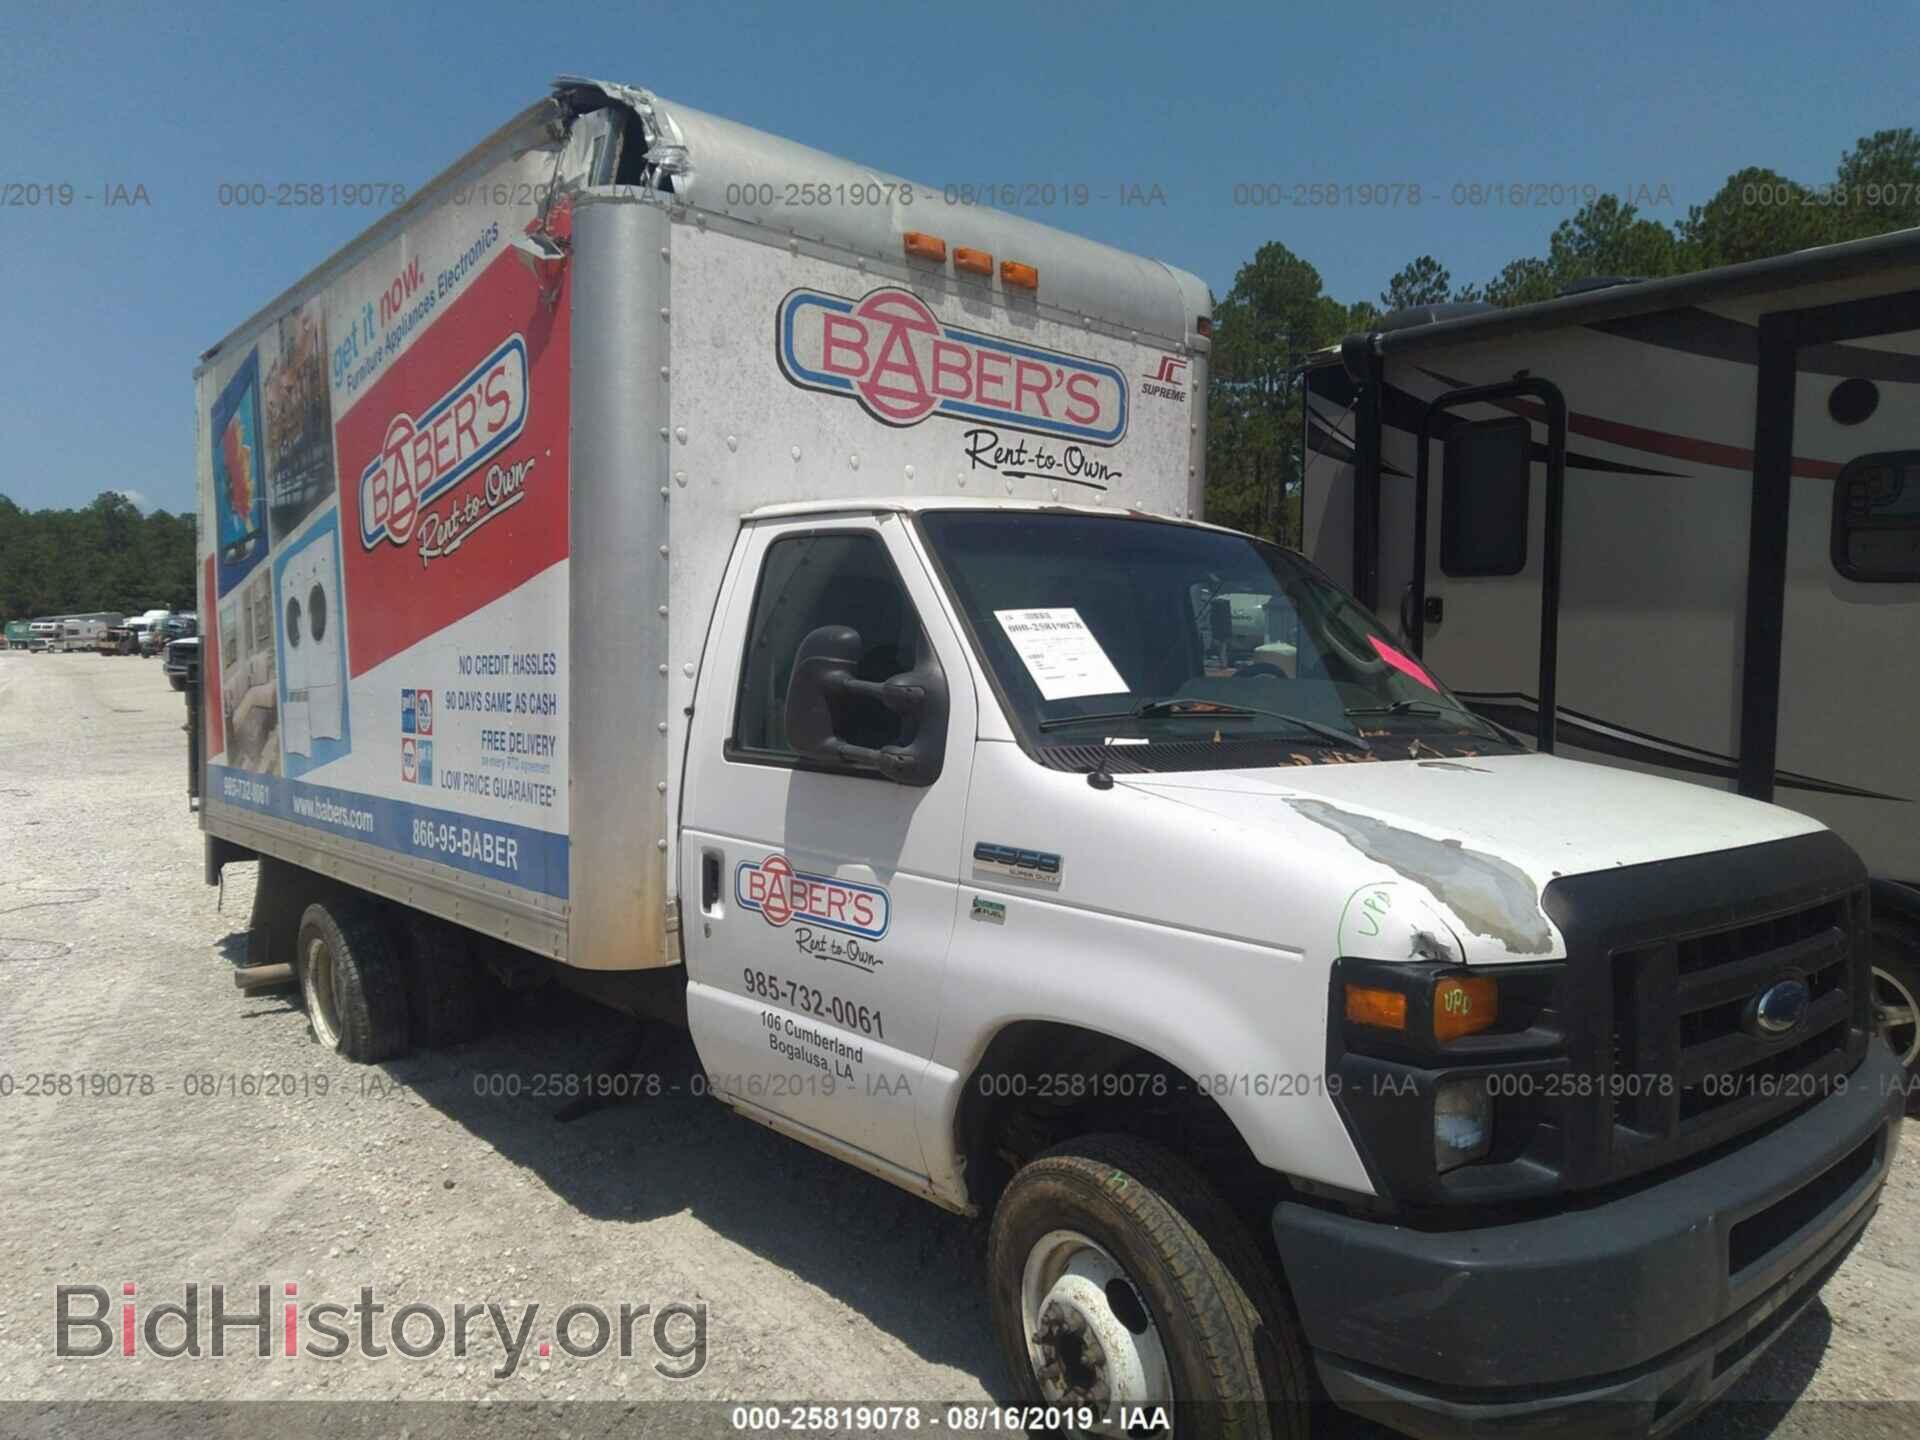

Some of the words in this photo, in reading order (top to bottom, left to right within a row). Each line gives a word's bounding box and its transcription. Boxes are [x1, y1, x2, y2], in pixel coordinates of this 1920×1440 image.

[384, 290, 436, 354] Appliances
[437, 221, 499, 299] Electronics
[333, 320, 358, 388] get
[362, 301, 376, 346] it
[380, 254, 424, 328] now.
[822, 308, 1101, 426] BABER'S
[1142, 382, 1187, 403] SUPREME
[370, 364, 511, 530] BABER'S
[964, 430, 1122, 484] Rent-to-Own
[458, 655, 472, 675] NO
[475, 654, 510, 676] CREDIT
[512, 653, 557, 676] HASSLES
[445, 691, 457, 711] 90
[458, 691, 482, 712] DAYS
[484, 691, 512, 713] SAME
[514, 693, 527, 715] AS
[529, 693, 557, 715] CASH
[481, 729, 506, 752] FREE
[508, 732, 556, 757] DELIVERY
[441, 769, 460, 790] LOW
[463, 772, 491, 796] PRICE
[292, 795, 374, 833] www.babers.com
[412, 818, 519, 871] 866-95-BABER
[749, 870, 874, 926] BABER'S
[744, 968, 884, 1040] 985-732-0061
[761, 1010, 781, 1032] 106
[784, 1019, 863, 1063] Cumberland
[769, 1034, 832, 1073] Bogalusa,
[835, 1060, 854, 1082] LA
